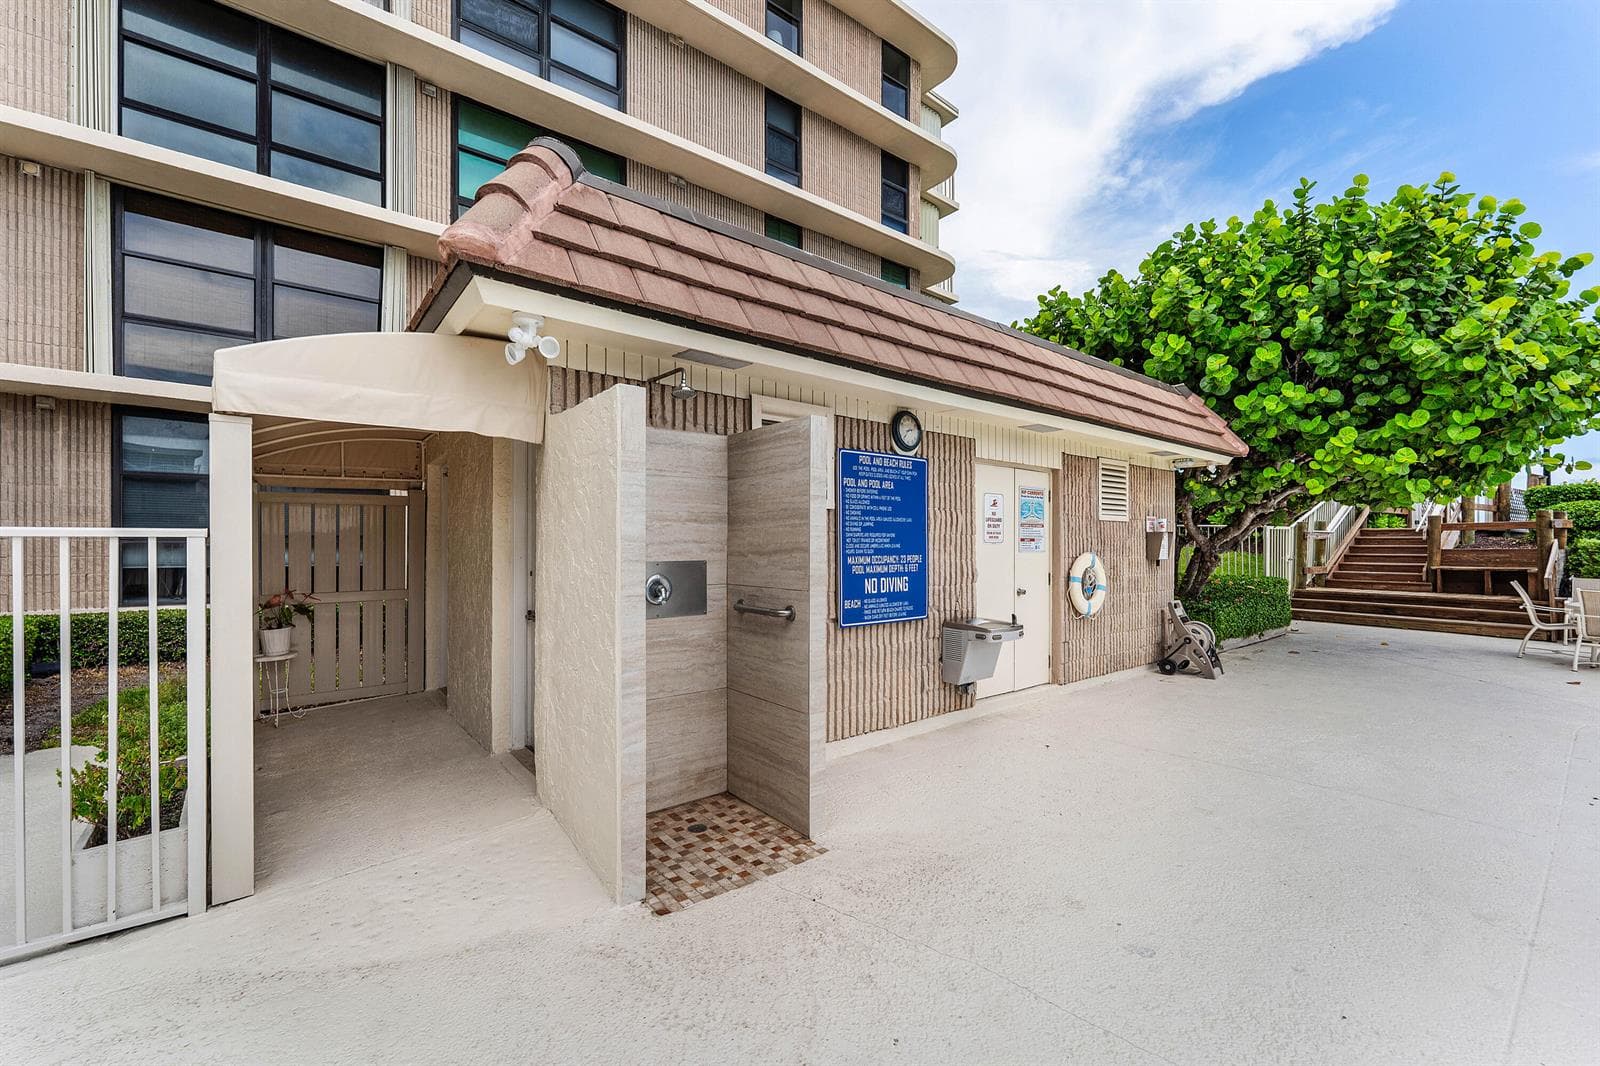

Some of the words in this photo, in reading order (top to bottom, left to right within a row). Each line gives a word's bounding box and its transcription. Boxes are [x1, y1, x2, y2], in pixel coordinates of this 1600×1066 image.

[859, 456, 871, 465] POOL
[873, 457, 882, 466] AND
[884, 458, 898, 468] BEACH
[899, 460, 912, 469] RULES
[844, 478, 856, 487] POOL
[858, 479, 868, 487] AND
[869, 480, 881, 488] POOL
[882, 481, 894, 489] AREA
[848, 556, 871, 565] MAXIMUM
[907, 554, 922, 563] PEOPLE
[852, 566, 865, 574] POOL
[866, 565, 888, 573] MAXIMUM
[909, 564, 918, 572] FEET
[865, 578, 878, 594] NO
[881, 576, 908, 593] DIVING
[844, 600, 861, 609] BEACH
